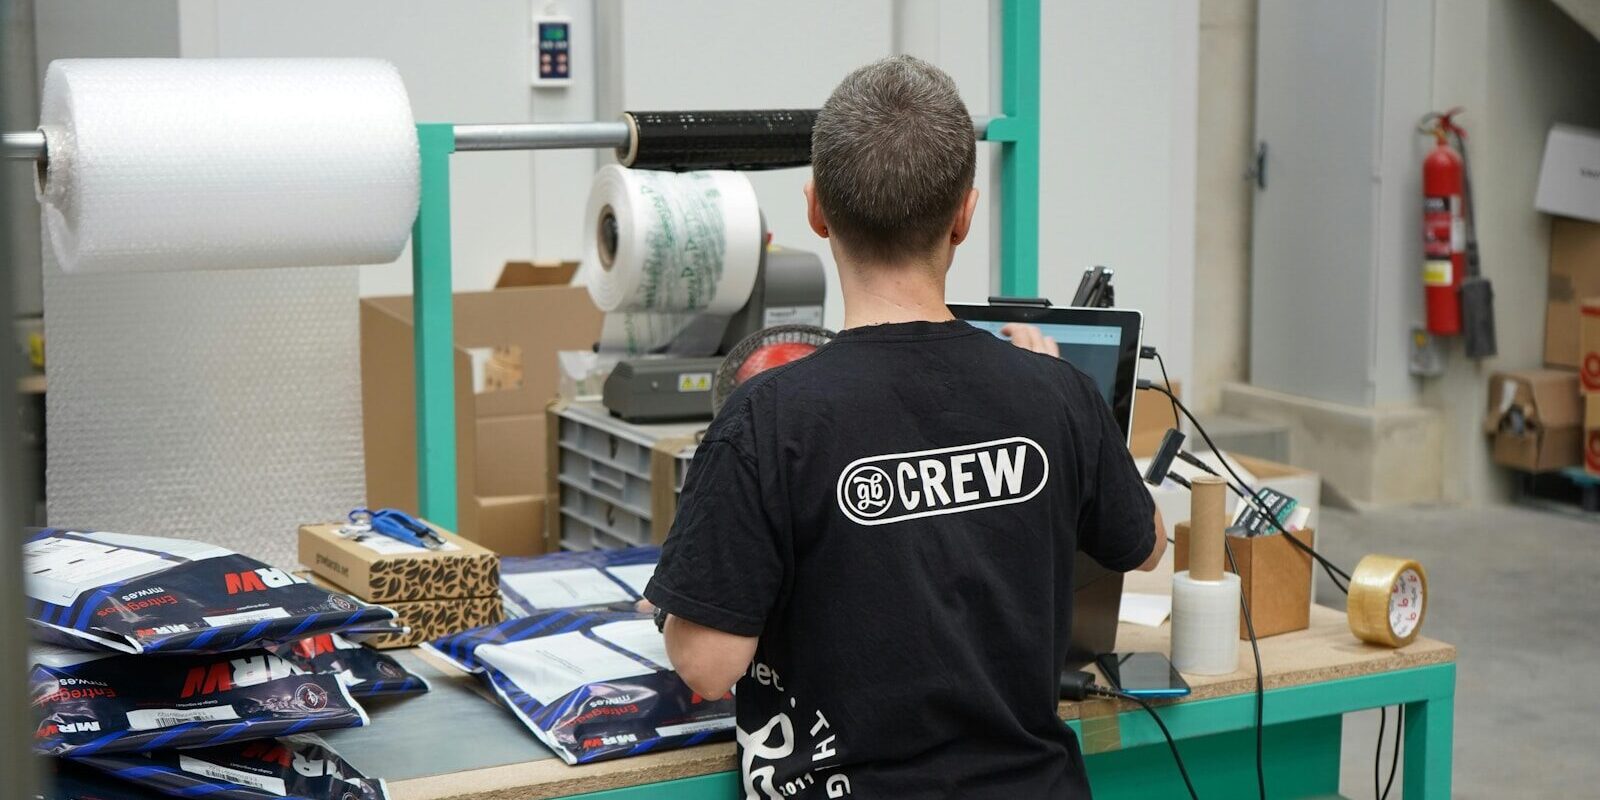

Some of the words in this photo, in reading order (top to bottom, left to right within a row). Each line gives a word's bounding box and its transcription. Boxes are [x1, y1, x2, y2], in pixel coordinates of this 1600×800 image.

[896, 444, 1027, 511] CREW
[121, 586, 164, 602] mrw.es
[59, 677, 108, 688] mrw.es
[582, 733, 638, 749] MRW
[779, 772, 816, 798] 2011
